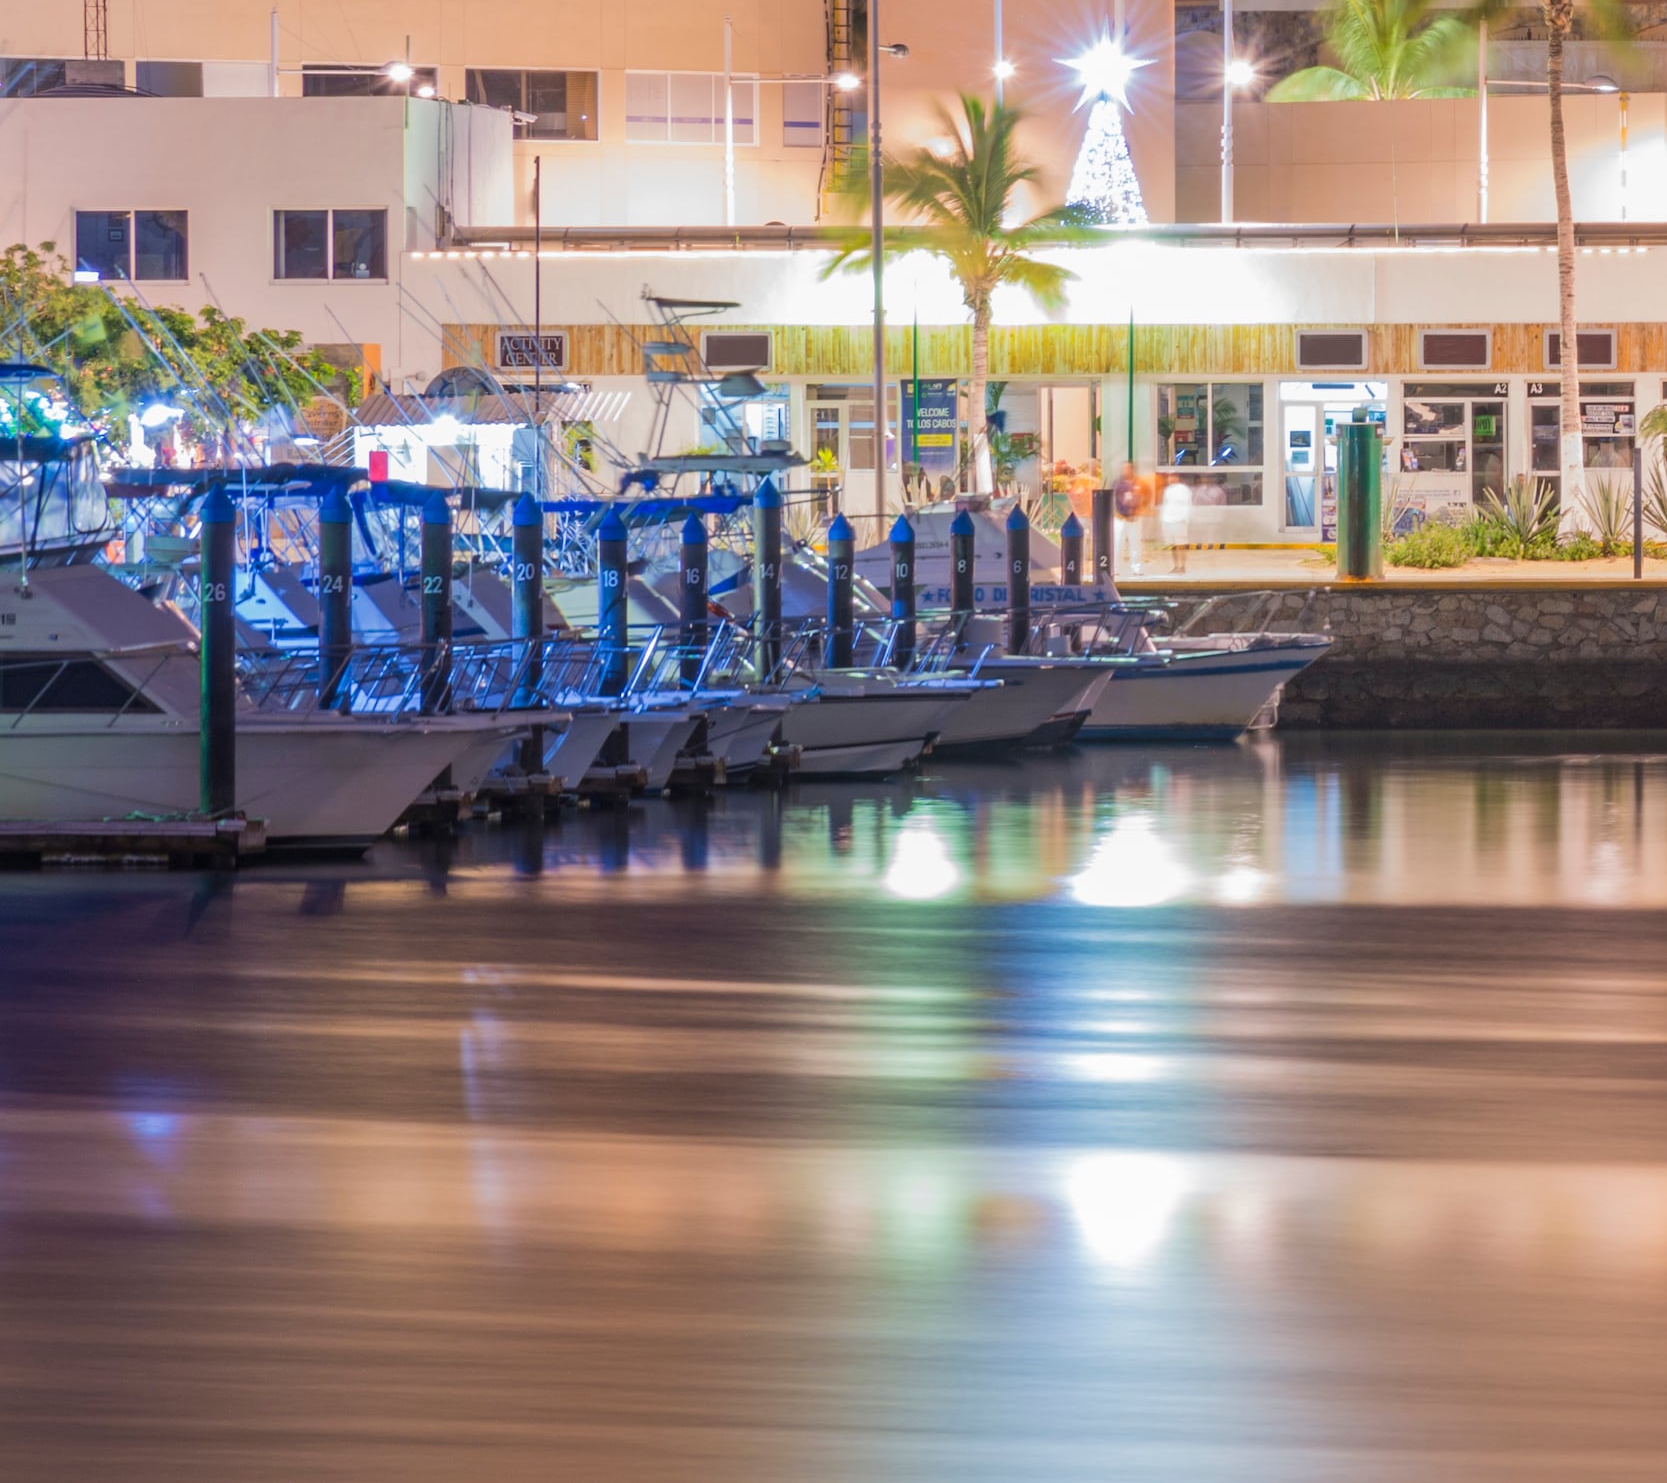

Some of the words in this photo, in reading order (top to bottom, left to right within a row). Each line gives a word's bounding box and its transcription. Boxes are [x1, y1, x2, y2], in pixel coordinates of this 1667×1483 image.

[502, 337, 560, 350] ACTIITY
[1494, 383, 1507, 394] A2
[1530, 383, 1543, 394] A3
[918, 419, 931, 428] LOS
[932, 419, 956, 428] CABOS
[957, 560, 966, 573] 8
[1013, 560, 1022, 573] 6
[1066, 560, 1075, 572] 4
[1100, 555, 1108, 567] 2
[517, 563, 535, 581] 20
[686, 568, 700, 584] 16
[759, 563, 774, 578] 14
[834, 564, 848, 579] 12
[896, 563, 908, 578] 10
[323, 574, 343, 593] 24
[423, 576, 442, 594] 22
[603, 570, 618, 588] 18
[204, 583, 226, 601] 26
[937, 588, 984, 602] FOO
[1030, 588, 1087, 602] RISTAL
